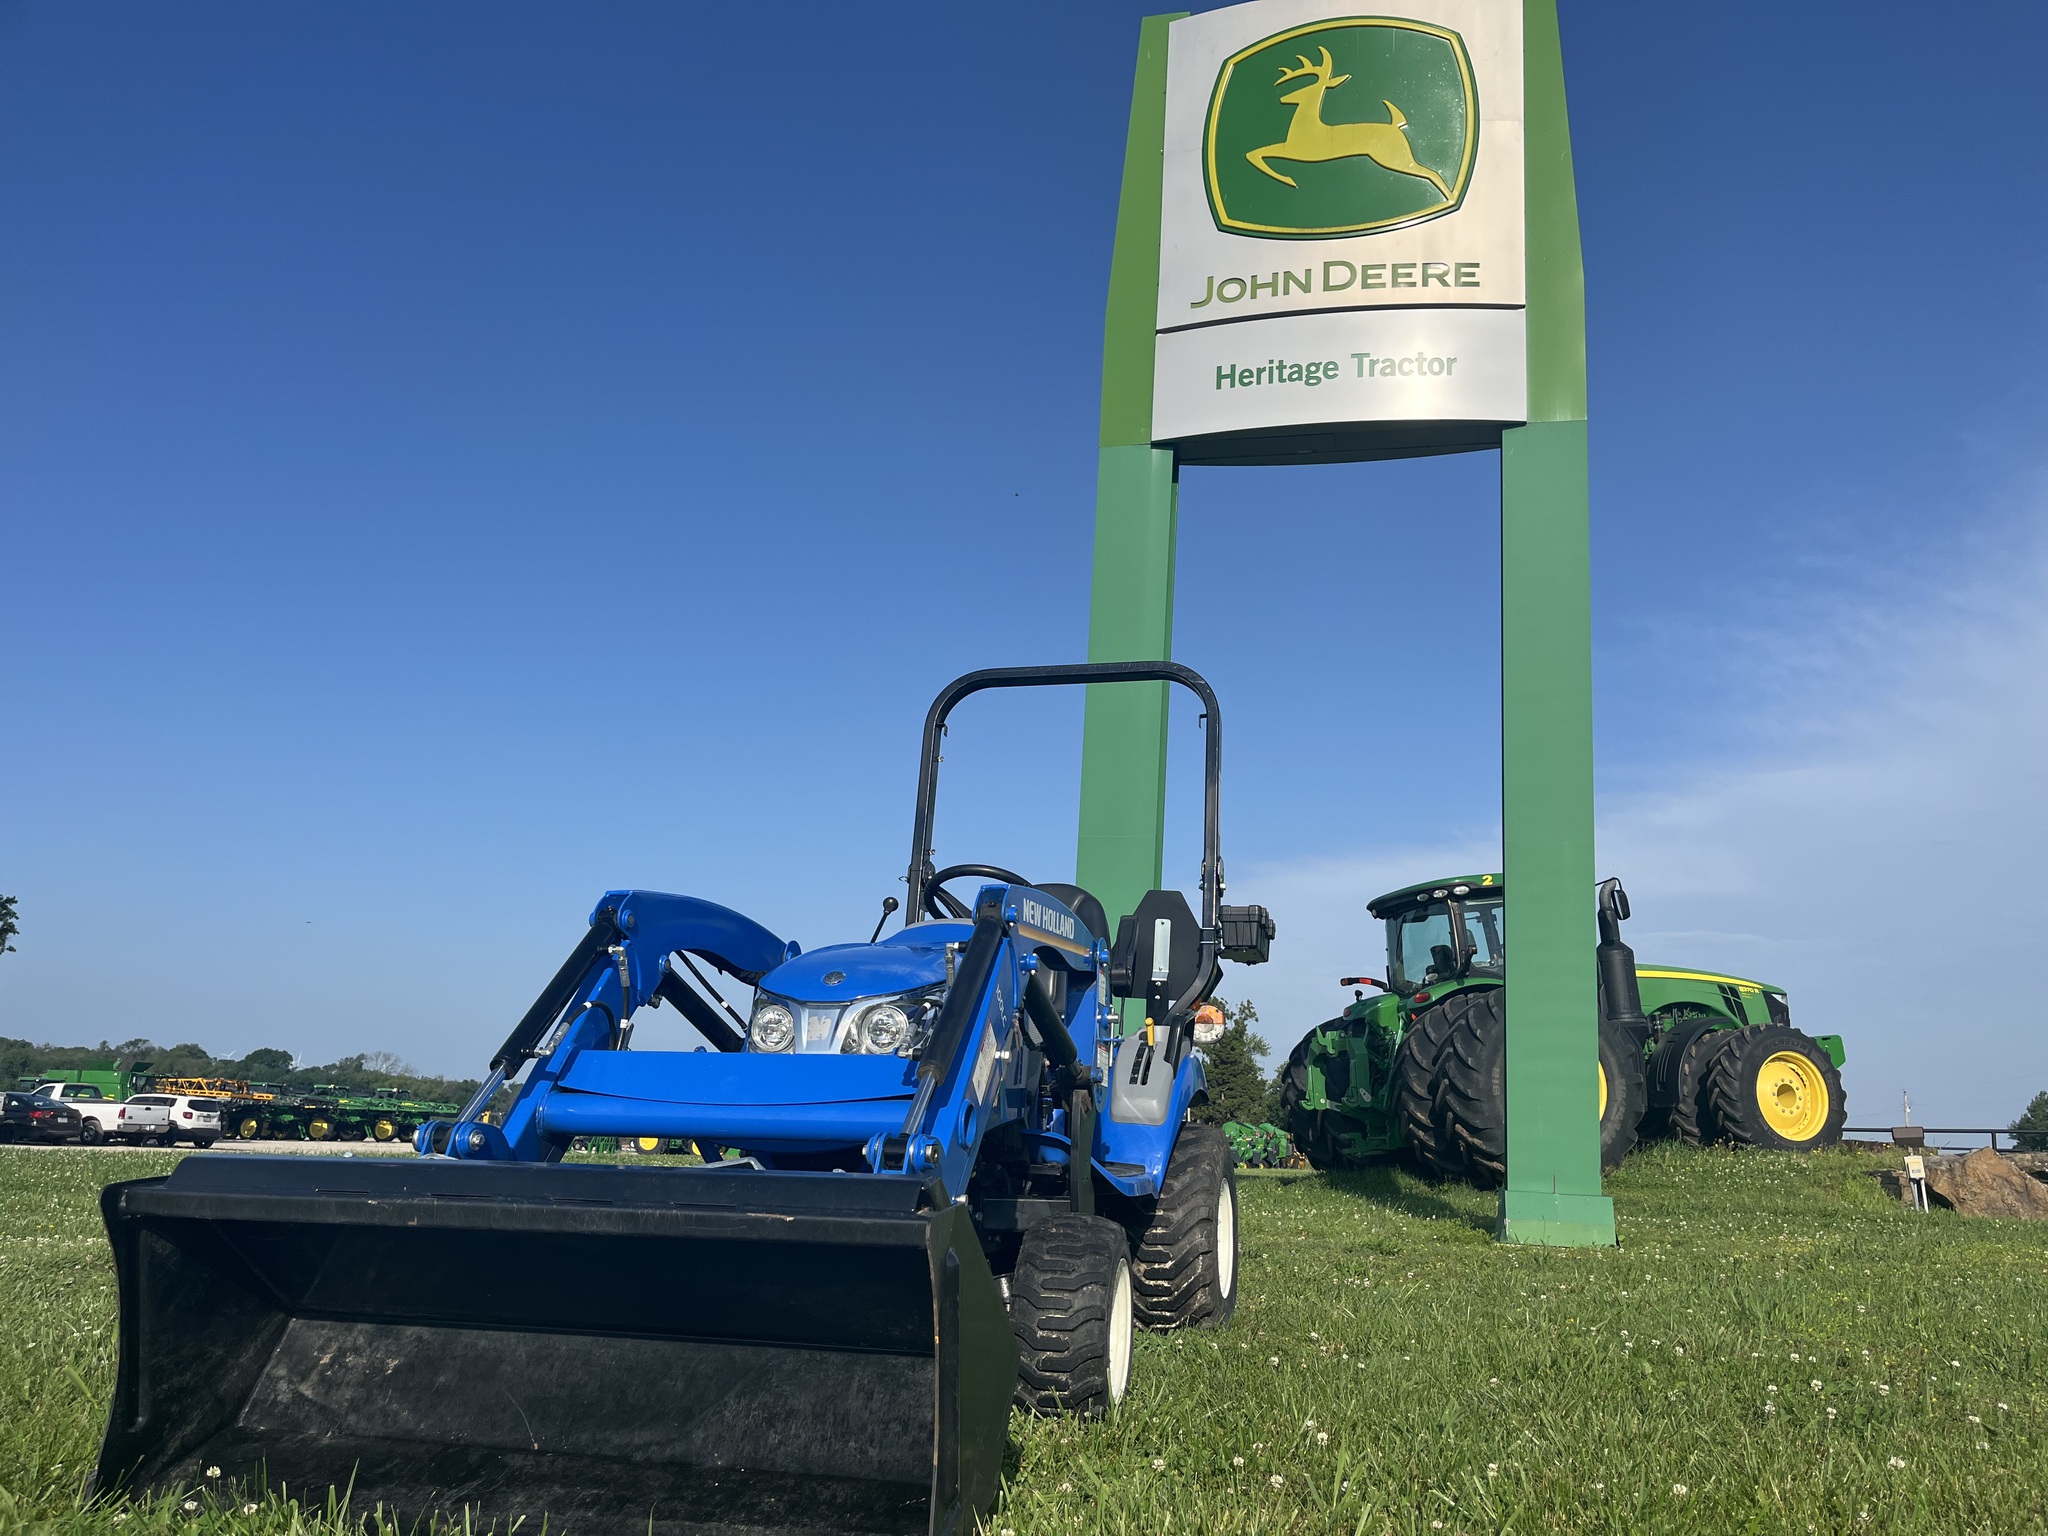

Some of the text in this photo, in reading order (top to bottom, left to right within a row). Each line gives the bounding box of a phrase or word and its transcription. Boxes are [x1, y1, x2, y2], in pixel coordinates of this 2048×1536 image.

[1190, 260, 1481, 309] JOHN DEERE
[1215, 352, 1457, 390] Heritage Tractor
[1482, 874, 1493, 886] 2
[1023, 898, 1075, 940] NEW HOLLAND
